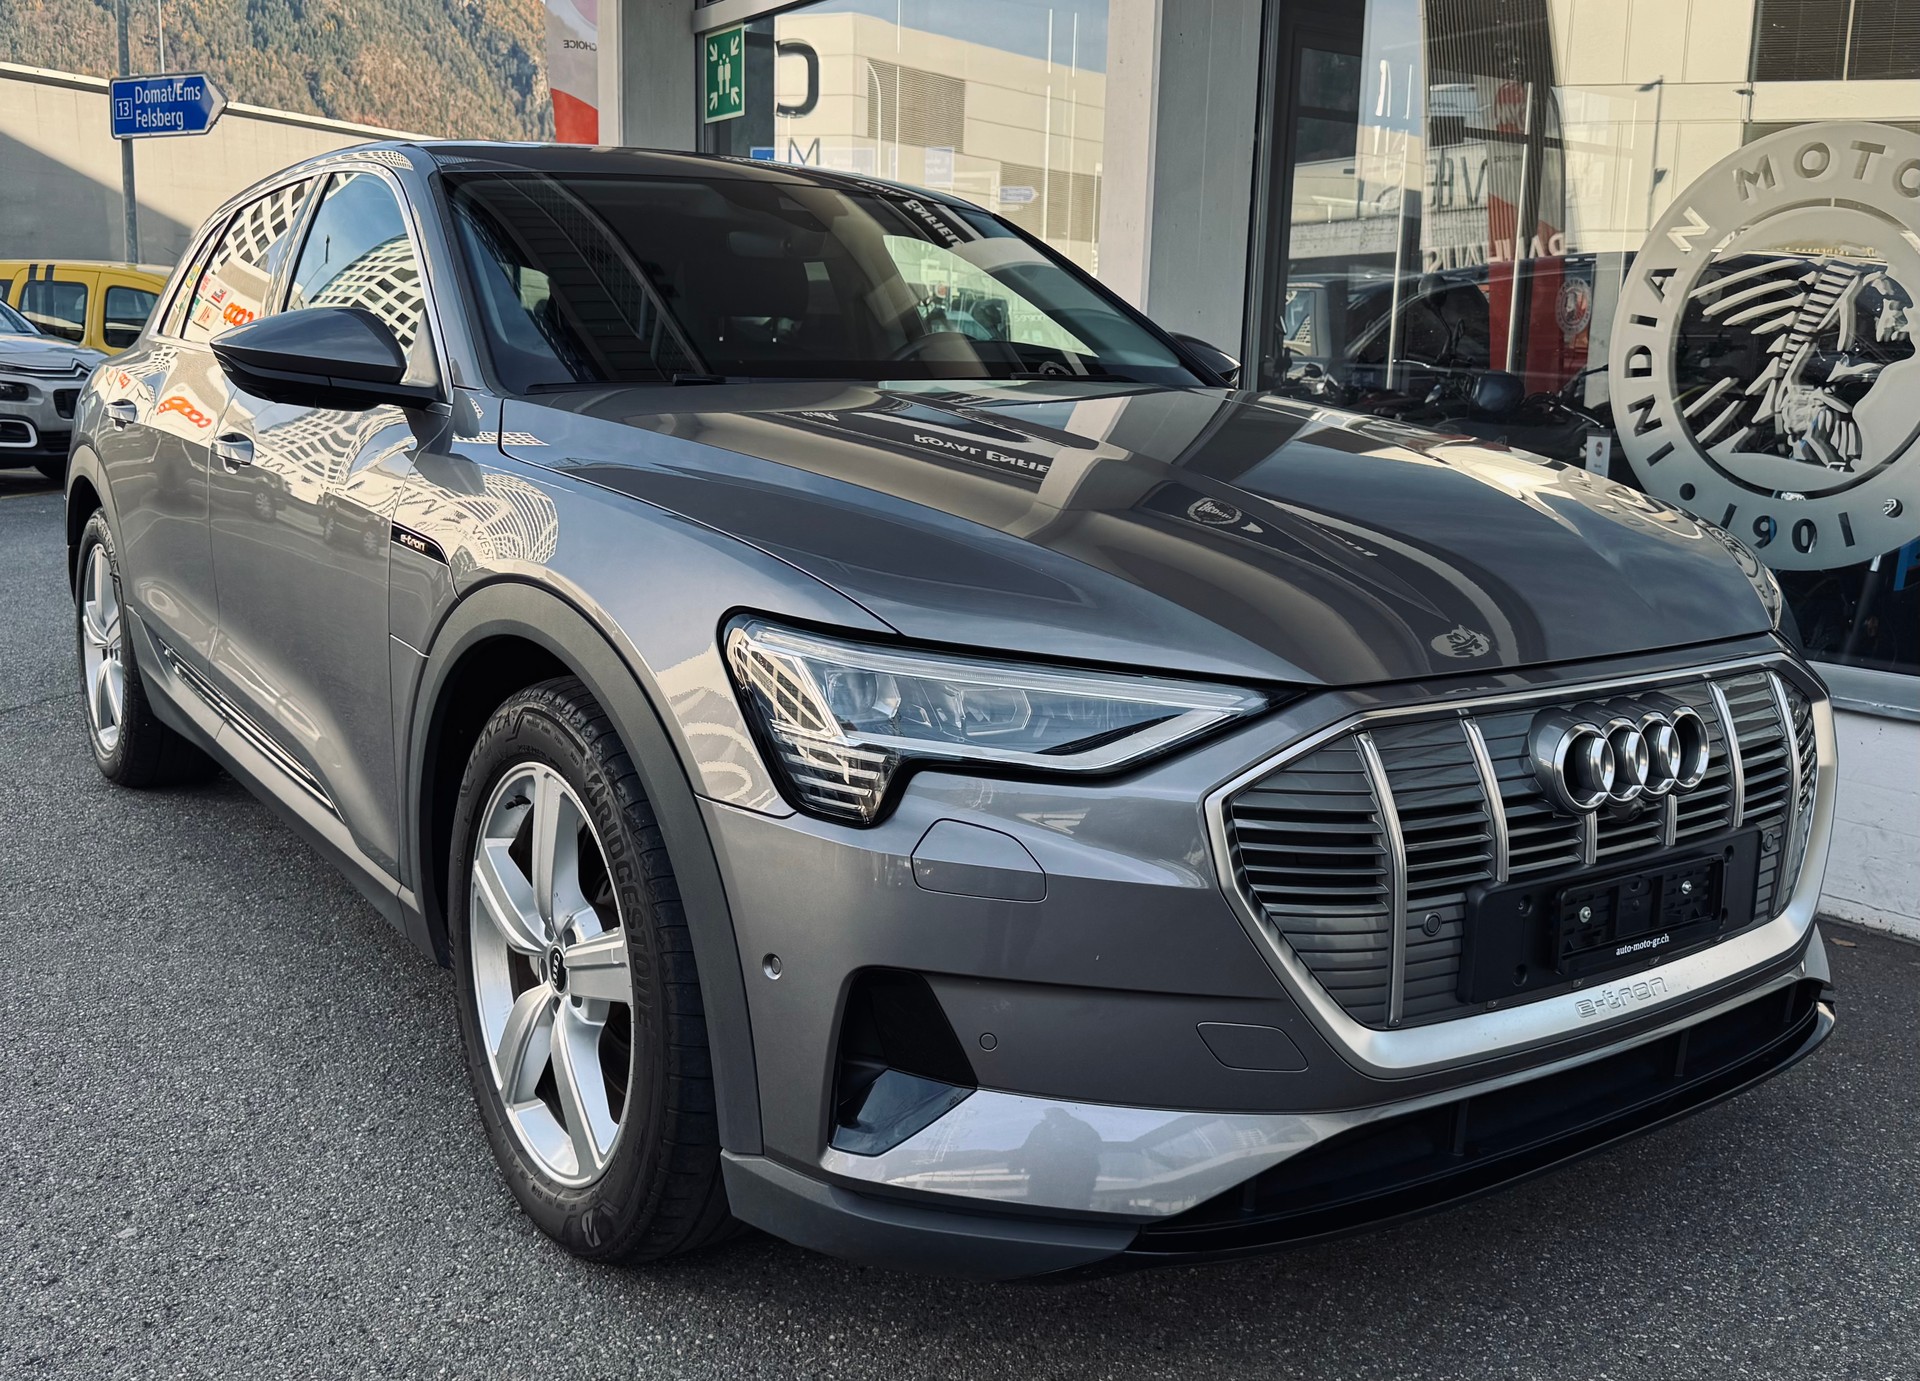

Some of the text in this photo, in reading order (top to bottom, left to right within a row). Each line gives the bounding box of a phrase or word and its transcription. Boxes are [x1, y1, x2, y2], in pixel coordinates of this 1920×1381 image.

[135, 82, 201, 105] Domat/Ems
[118, 101, 130, 117] 13
[135, 107, 184, 131] Felsberg
[1624, 206, 1710, 467] INDIAN
[1719, 503, 1856, 554] 1901
[400, 533, 426, 552] e-tron
[1615, 933, 1670, 956] auto-moto-gr.ch
[1574, 976, 1669, 1018] e-tron
